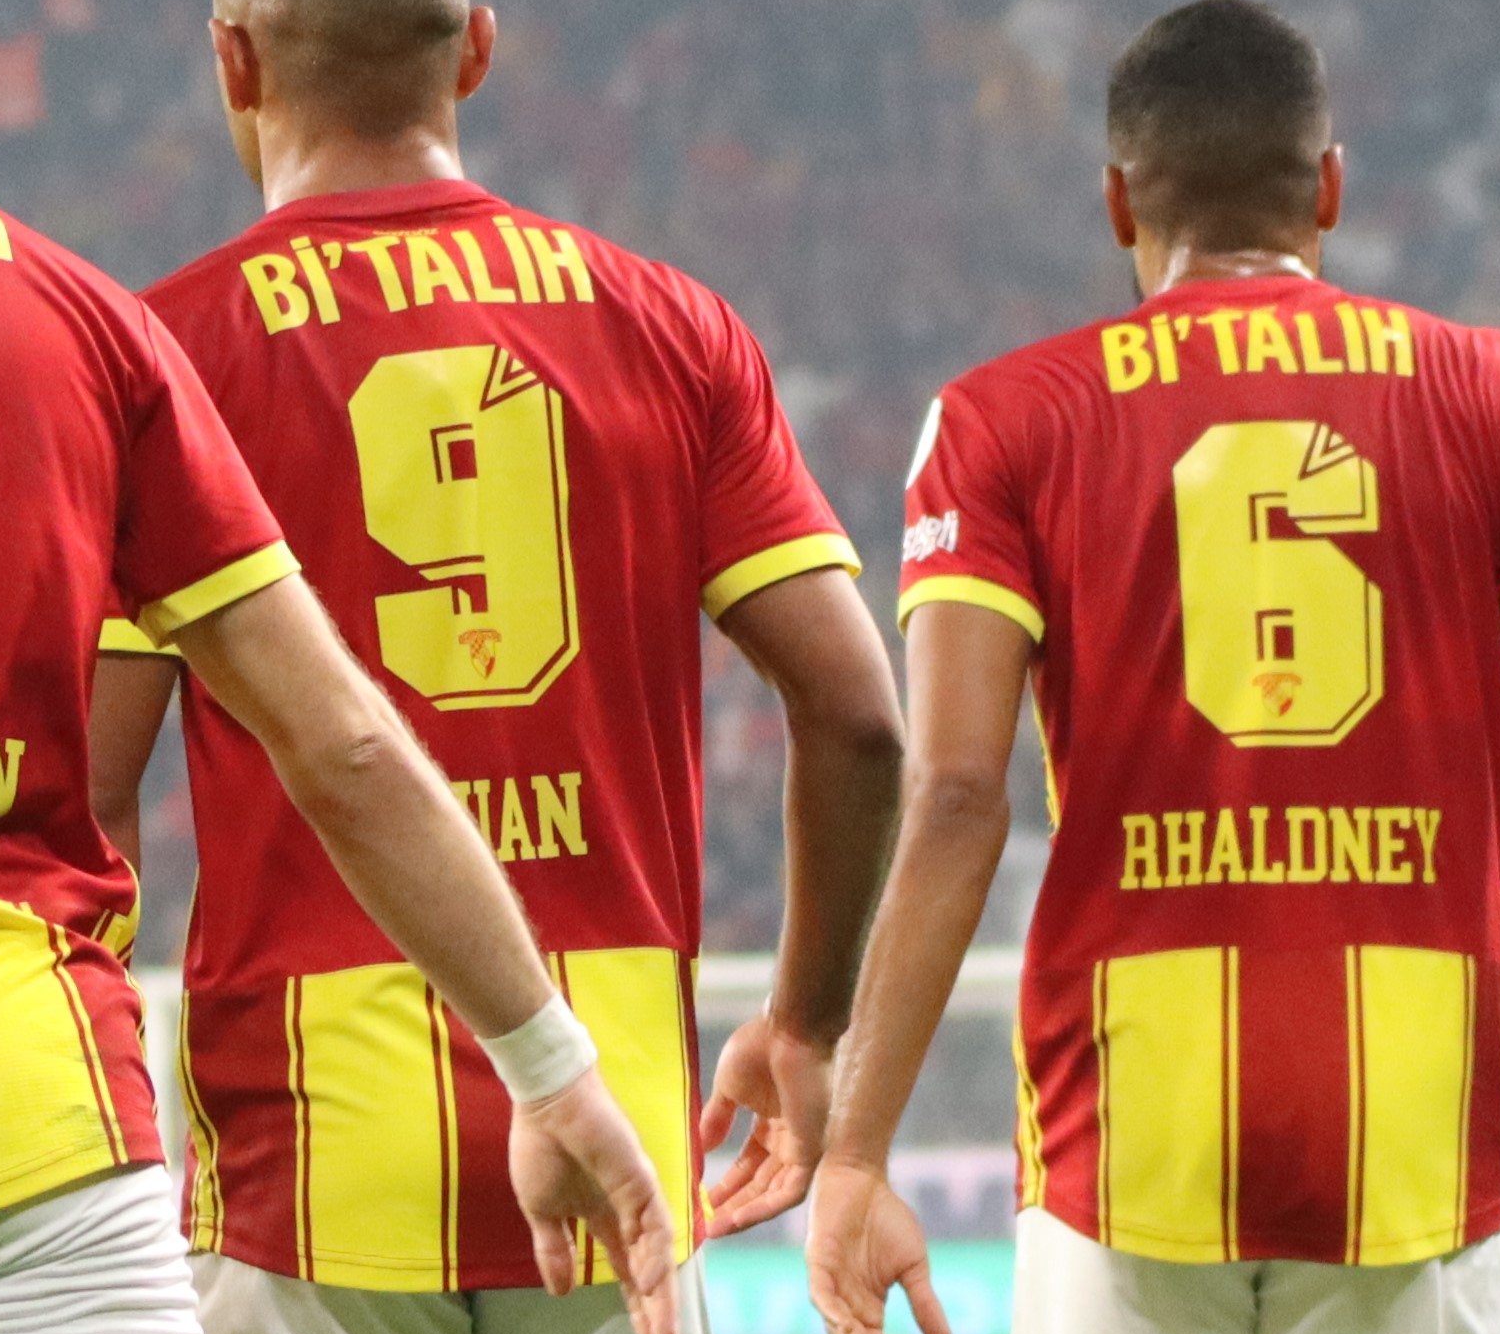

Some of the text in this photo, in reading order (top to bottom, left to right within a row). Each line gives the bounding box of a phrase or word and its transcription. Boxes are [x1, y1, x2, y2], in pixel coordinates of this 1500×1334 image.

[347, 344, 581, 712] 9
[1172, 420, 1384, 748] 6
[1119, 806, 1442, 890] RHALDNEY
